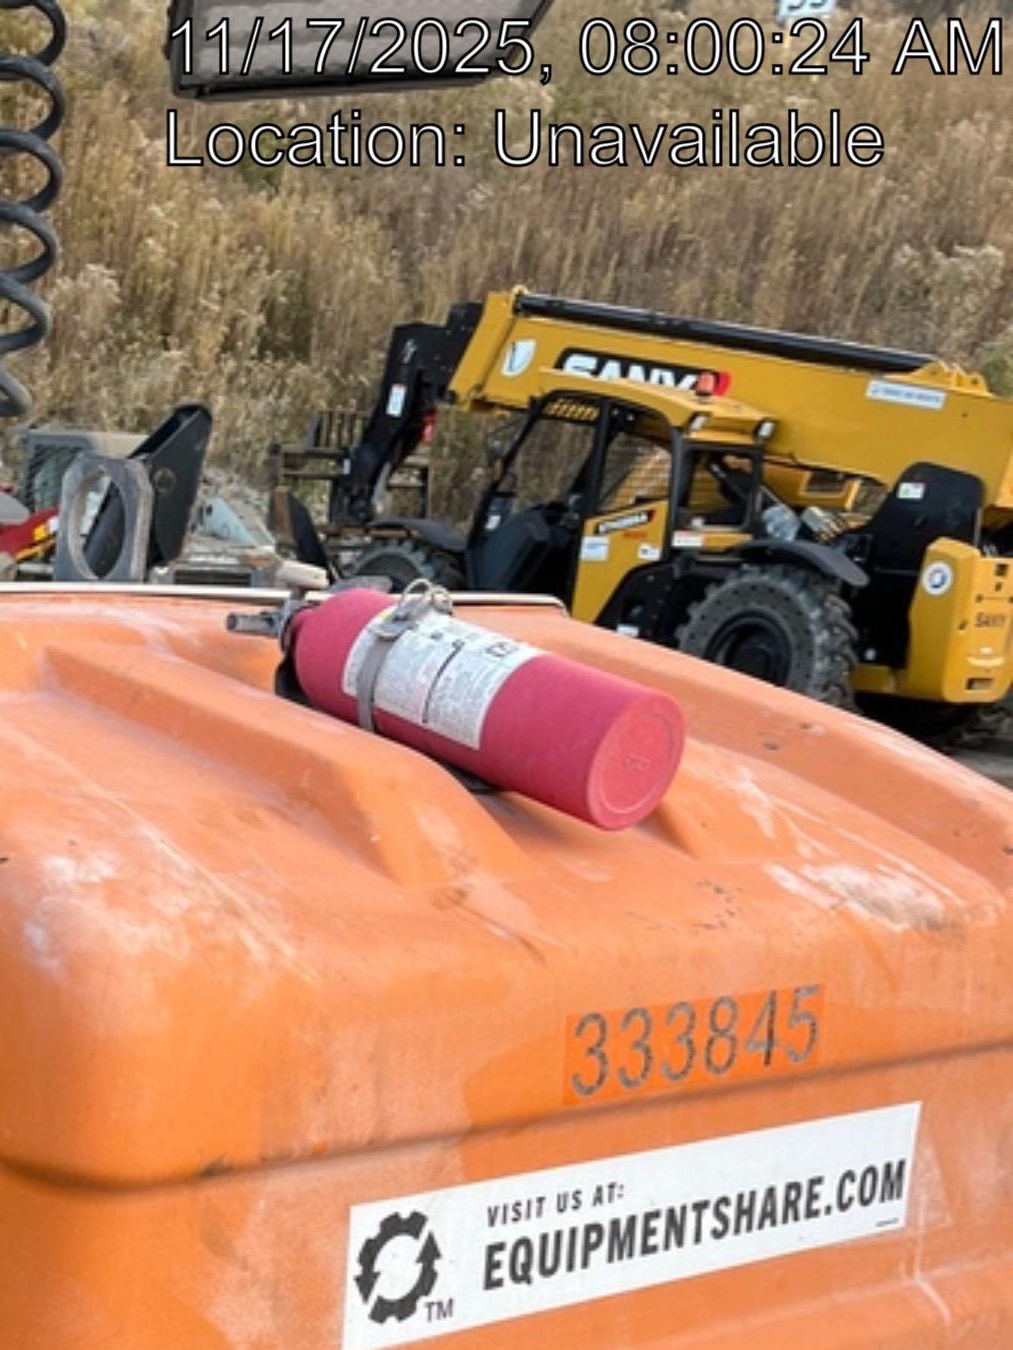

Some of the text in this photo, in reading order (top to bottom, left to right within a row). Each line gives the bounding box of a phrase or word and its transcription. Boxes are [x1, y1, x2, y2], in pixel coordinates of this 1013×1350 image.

[570, 984, 822, 1098] 333845
[483, 1159, 907, 1291] EQUIPMENTSHARE.COM
[486, 1182, 625, 1228] VISIT US AT:
